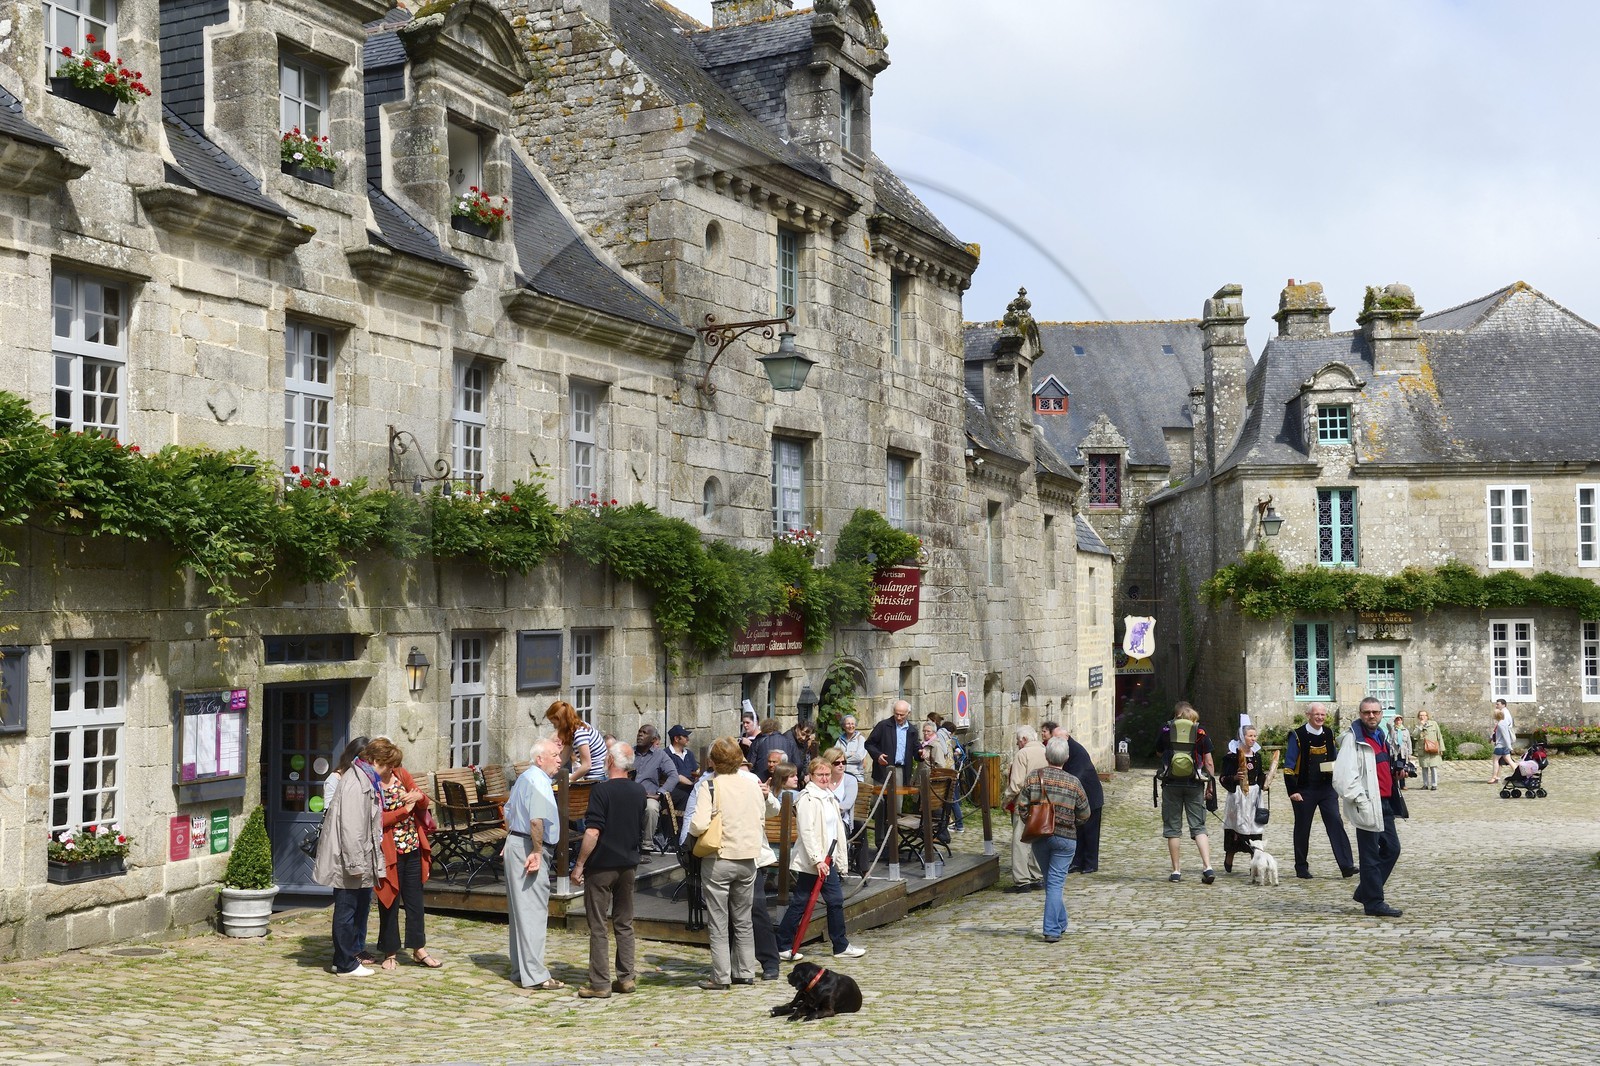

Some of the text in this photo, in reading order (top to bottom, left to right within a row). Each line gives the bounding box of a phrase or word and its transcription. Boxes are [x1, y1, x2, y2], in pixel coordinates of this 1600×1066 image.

[870, 594, 914, 606] Pâtissier
[871, 611, 912, 623] Le Guillou
[732, 640, 750, 655] Kouign
